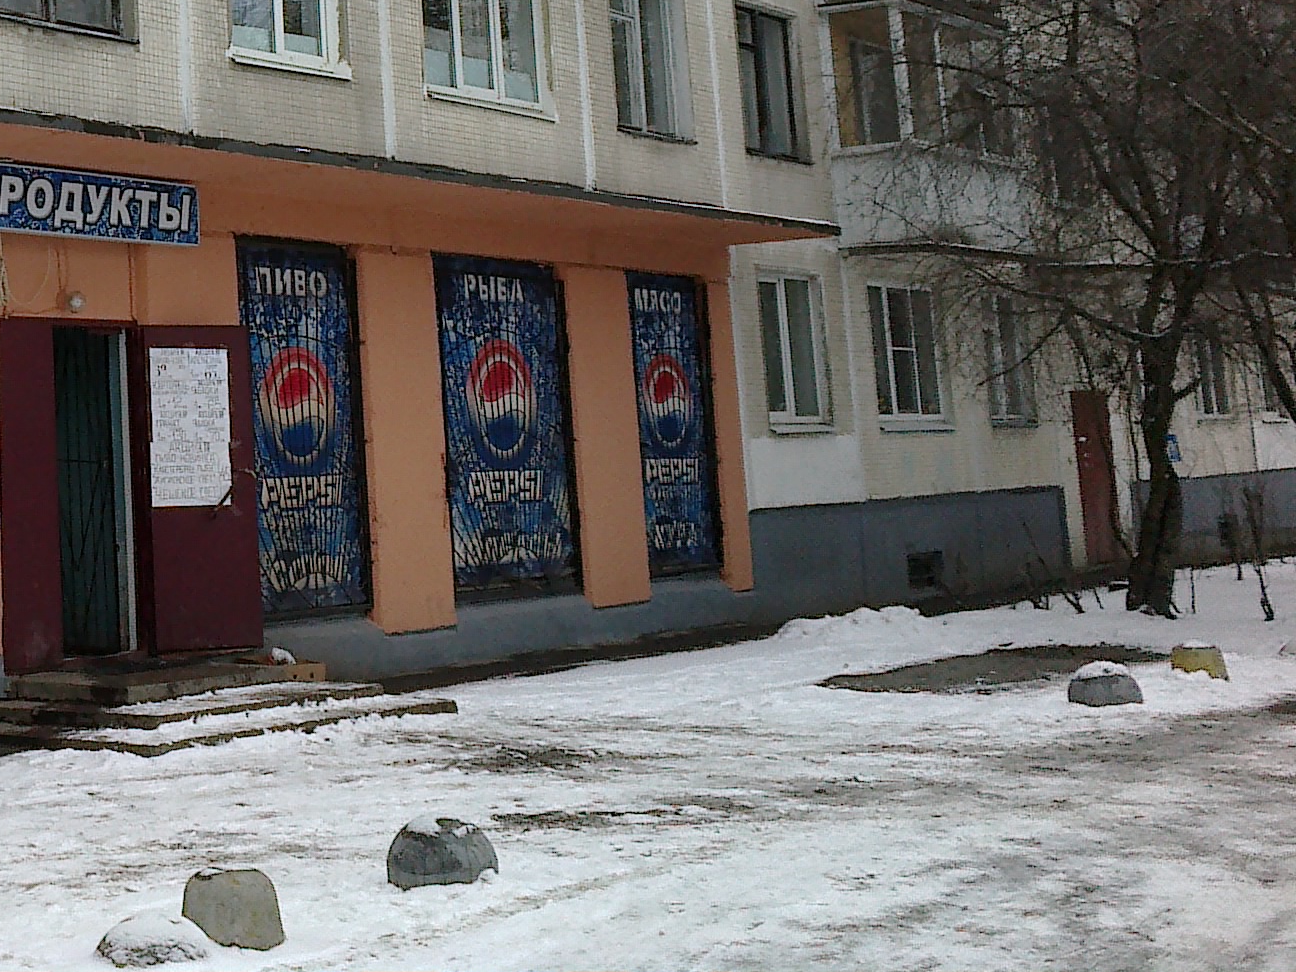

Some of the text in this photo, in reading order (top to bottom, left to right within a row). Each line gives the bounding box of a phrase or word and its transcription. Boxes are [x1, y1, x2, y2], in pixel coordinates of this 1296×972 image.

[256, 266, 328, 299] ПИВО
[463, 273, 525, 304] РЫБА
[466, 469, 544, 504] PEPSI
[645, 457, 699, 483] PEPSI
[260, 474, 343, 510] PEPSI
